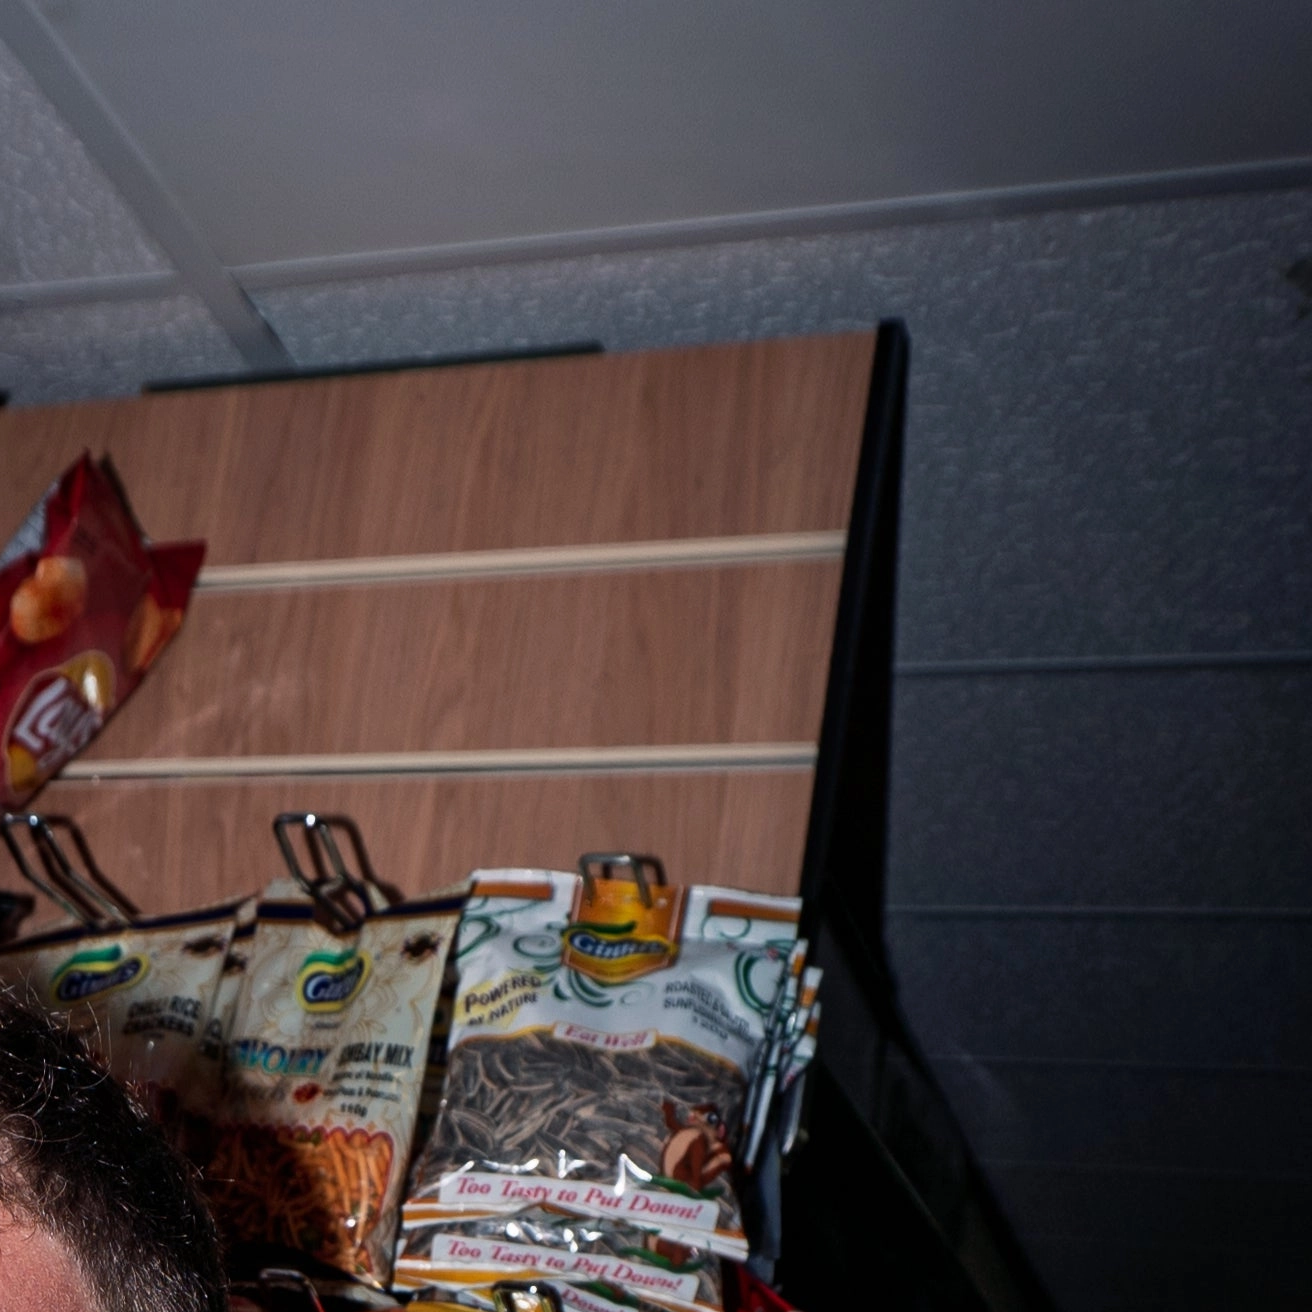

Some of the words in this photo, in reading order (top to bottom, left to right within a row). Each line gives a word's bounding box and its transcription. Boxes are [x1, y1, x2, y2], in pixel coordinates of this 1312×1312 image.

[464, 974, 543, 1012] POWERED
[490, 992, 540, 1021] NATURE
[456, 1177, 492, 1195] Too
[501, 1178, 553, 1203] Tasty
[558, 1183, 576, 1202] to
[584, 1186, 624, 1208] Put
[628, 1194, 703, 1220] Down!
[448, 1239, 482, 1259] Too
[491, 1245, 542, 1271] Tasty
[546, 1251, 566, 1270] to
[573, 1255, 608, 1276] Put
[612, 1263, 683, 1291] Down!
